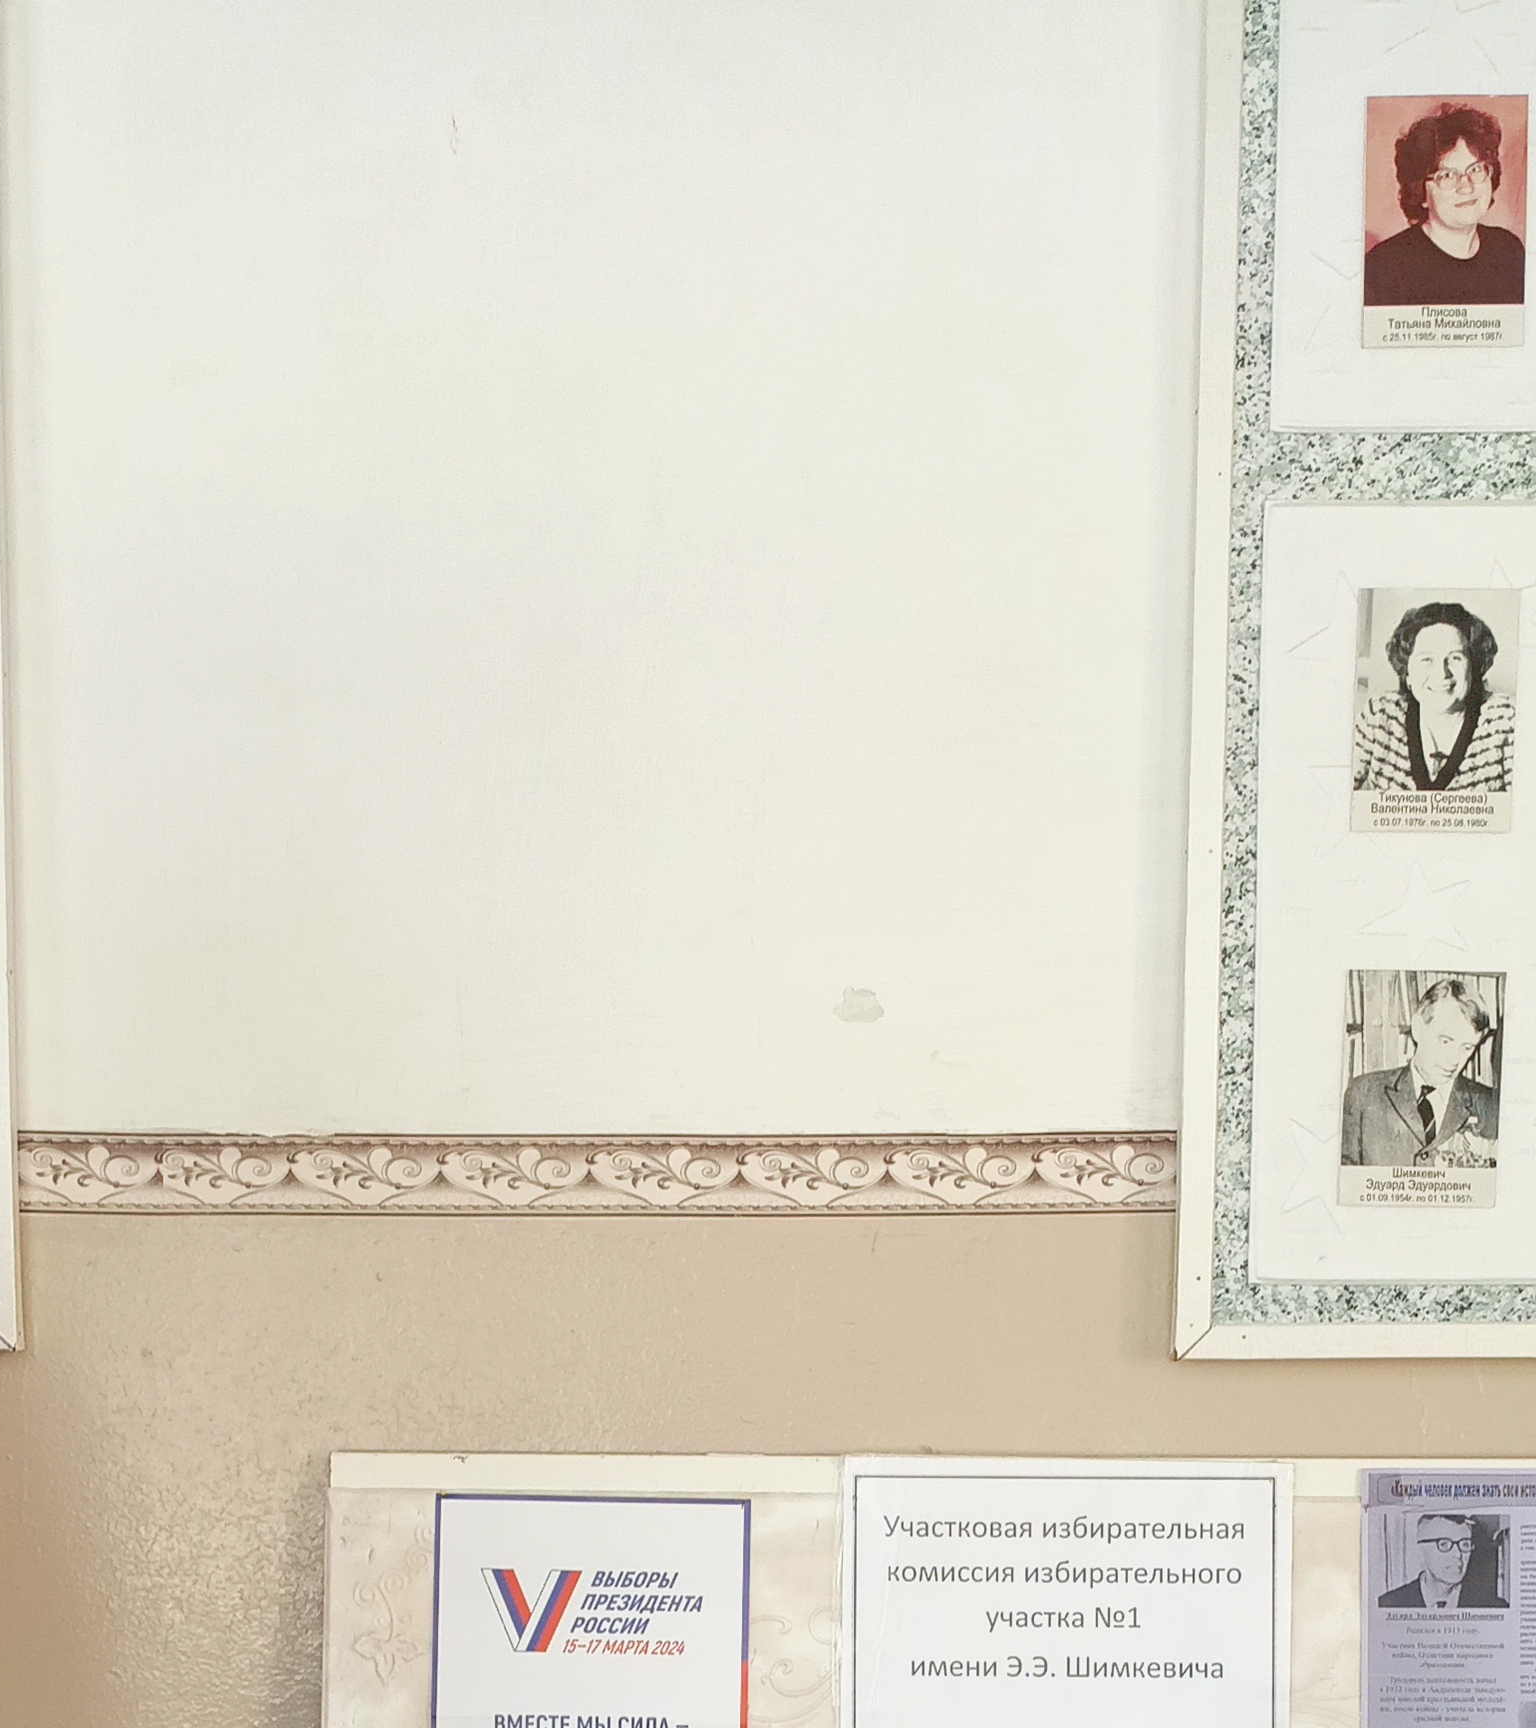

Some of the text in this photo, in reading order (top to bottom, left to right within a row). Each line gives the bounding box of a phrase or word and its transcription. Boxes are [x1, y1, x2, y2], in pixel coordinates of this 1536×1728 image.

[1421, 307, 1467, 317] Плисова
[1389, 318, 1501, 329] Татьяна Михайловна
[1379, 793, 1488, 805] Тикунова (Сергеева)
[1370, 803, 1494, 814] Валентина Николаевна
[1392, 1167, 1445, 1178] Шимкевич
[1366, 1179, 1471, 1192] Эдуард Эдуардович
[1424, 1484, 1452, 1498] человек
[1453, 1484, 1480, 1500] должен
[1481, 1484, 1501, 1498] знать
[883, 1515, 1245, 1544] Участковая избирательная
[591, 1571, 679, 1589] ВЫБОРЫ
[887, 1561, 1243, 1589] комиссия избирательного
[580, 1593, 704, 1614] ПРЕЗИДЕНТА
[570, 1616, 650, 1635] РОССИИ
[985, 1606, 1141, 1633] участка №1
[602, 1639, 649, 1655] МАРТА
[651, 1640, 685, 1656] 2024
[910, 1656, 1224, 1679] имени Э.Э. Шимкевича
